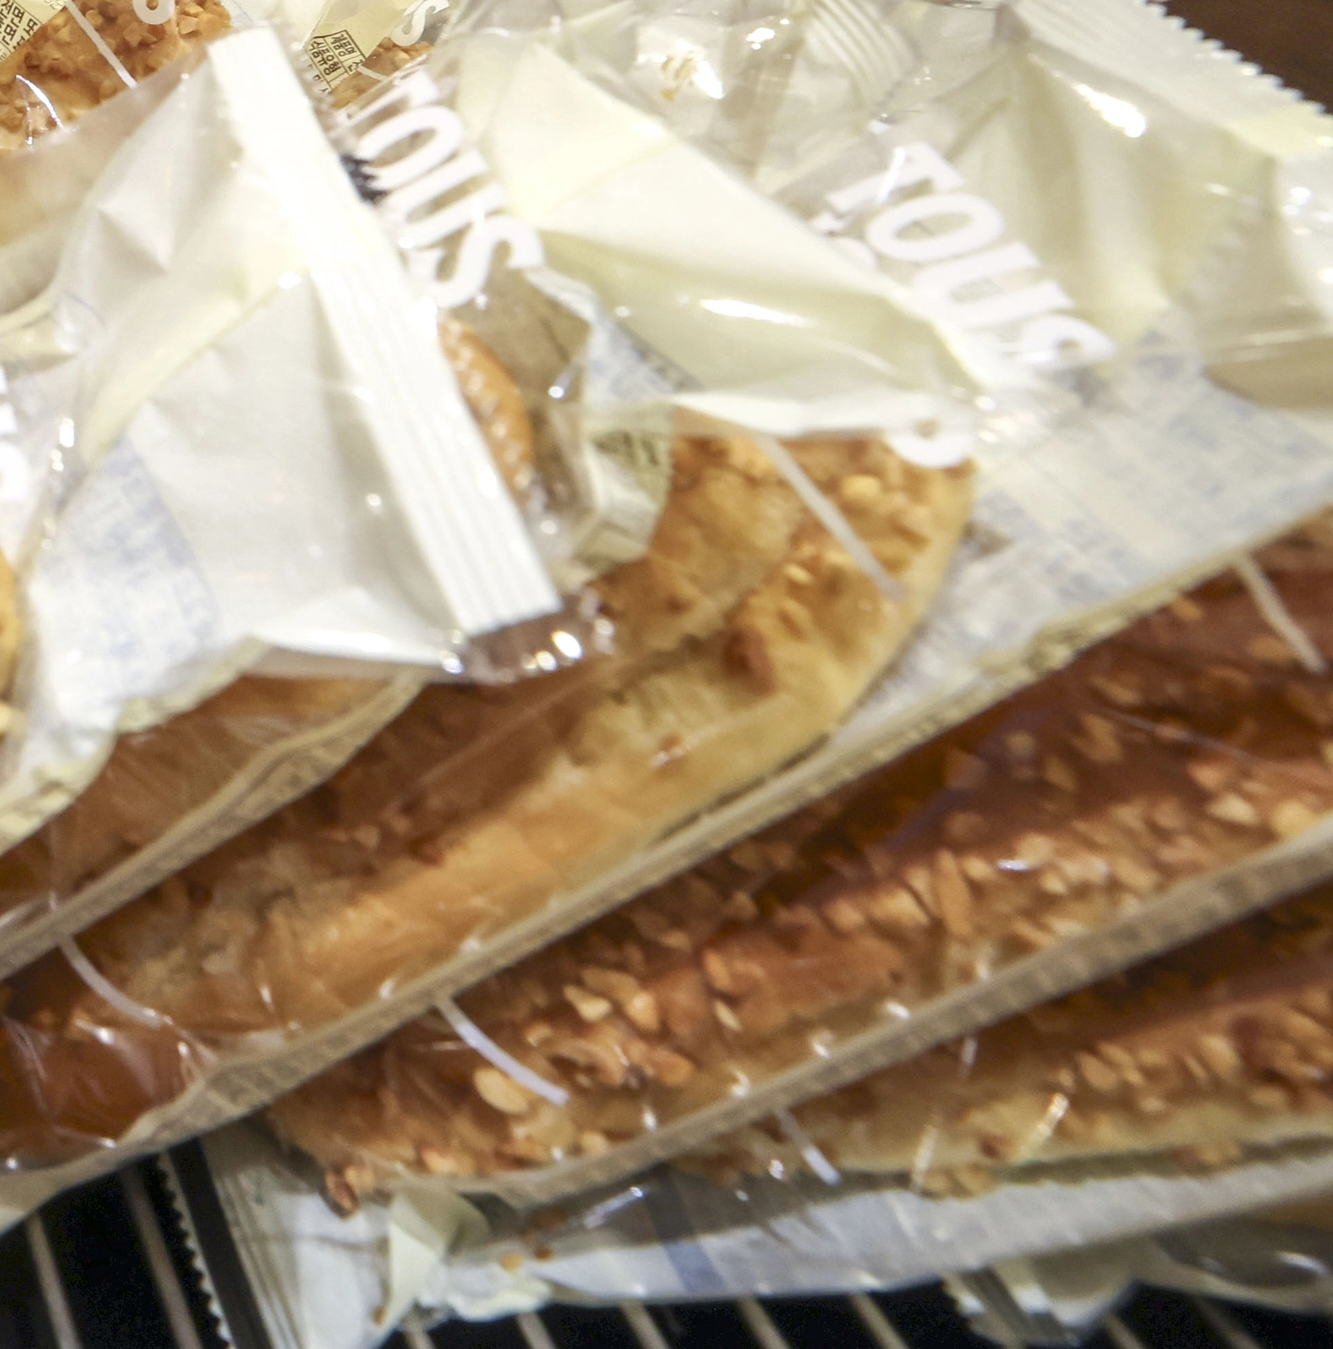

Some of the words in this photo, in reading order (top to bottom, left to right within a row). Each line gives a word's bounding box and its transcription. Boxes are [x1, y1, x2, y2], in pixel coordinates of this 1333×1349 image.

[305, 39, 342, 77] 식품유형
[327, 31, 357, 61] 제품명
[336, 66, 545, 310] TOUS
